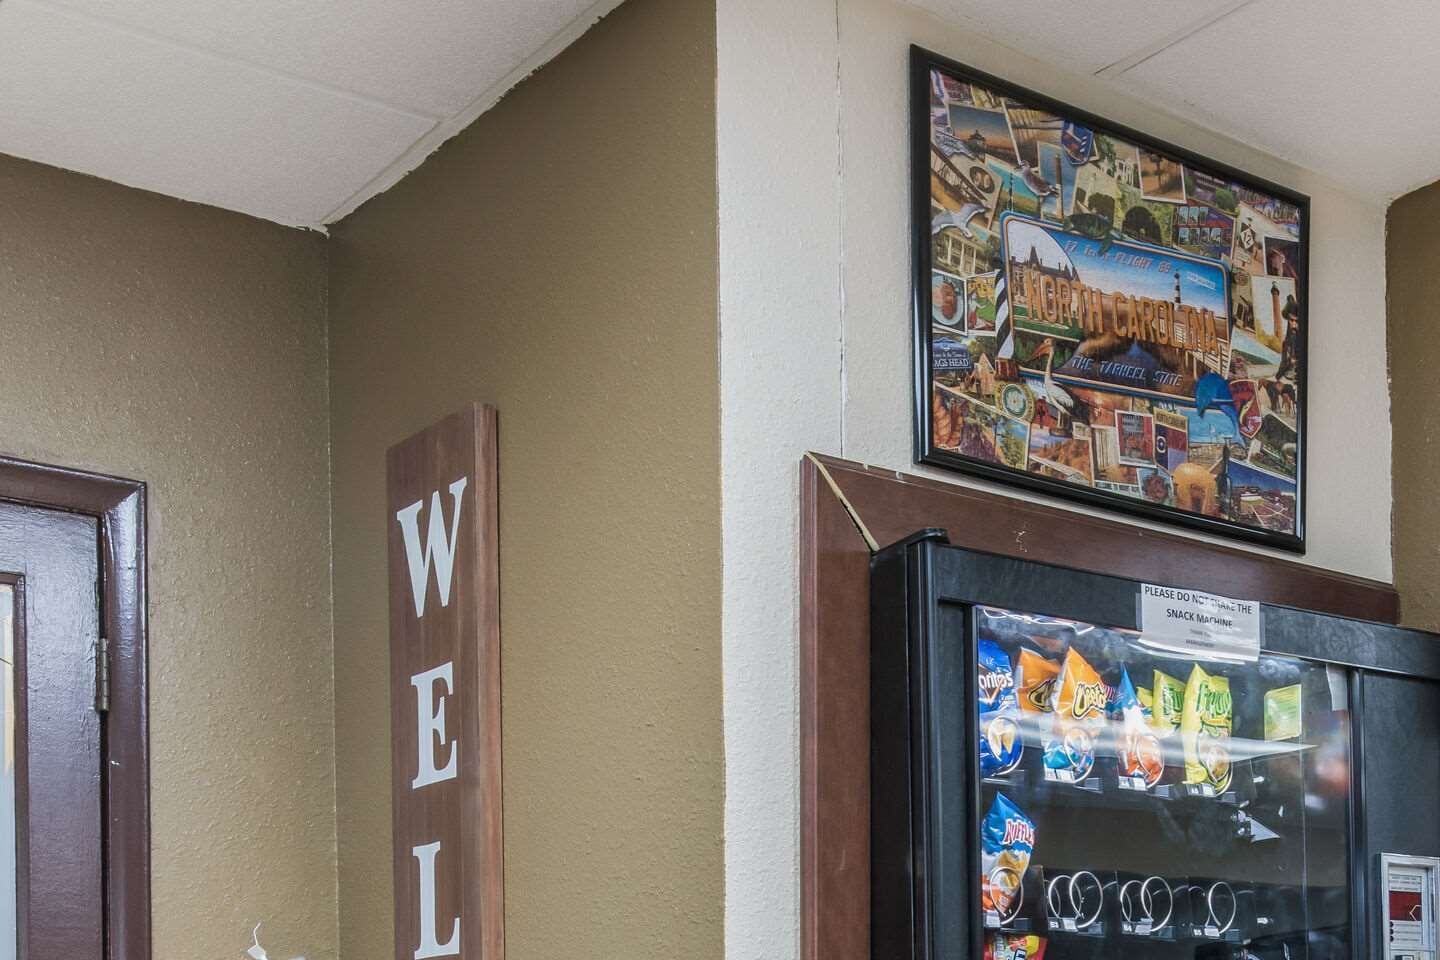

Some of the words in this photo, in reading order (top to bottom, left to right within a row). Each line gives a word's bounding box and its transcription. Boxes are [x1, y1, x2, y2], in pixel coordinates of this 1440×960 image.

[1024, 270, 1104, 334] NORTH
[1112, 291, 1219, 353] CAROLINA
[1071, 356, 1095, 372] THE
[1099, 360, 1147, 382] TARHEEL
[1152, 370, 1184, 387] STATE
[1144, 586, 1175, 600] PLEASE
[1177, 591, 1190, 602] DO
[1192, 594, 1209, 605] NOT
[1237, 603, 1252, 614] THE
[1166, 608, 1194, 621] SNACK
[1196, 614, 1233, 628] MACHINE
[978, 671, 1014, 689] oritos
